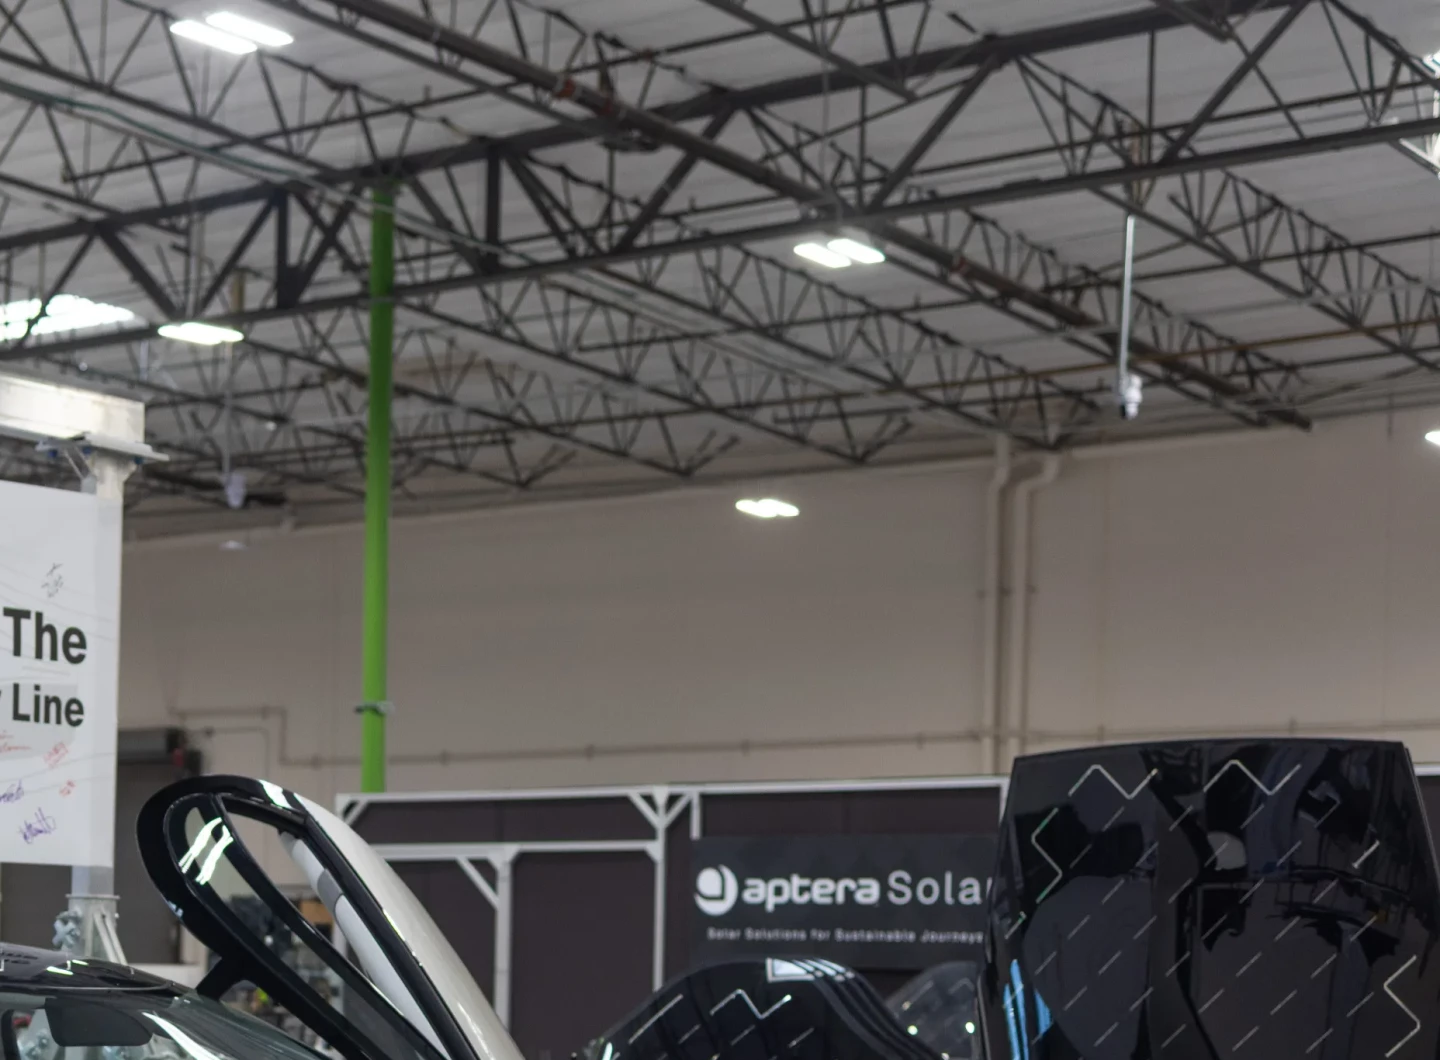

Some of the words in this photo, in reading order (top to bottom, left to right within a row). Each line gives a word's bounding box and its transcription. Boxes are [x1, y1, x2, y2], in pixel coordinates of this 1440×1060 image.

[2, 606, 87, 665] The
[12, 682, 85, 727] Line
[742, 873, 880, 912] aptera
[706, 927, 741, 941] Solar
[744, 927, 807, 942] Solutions
[811, 928, 831, 941] for
[834, 928, 916, 943] Sustainable
[919, 929, 984, 945] Journeys
